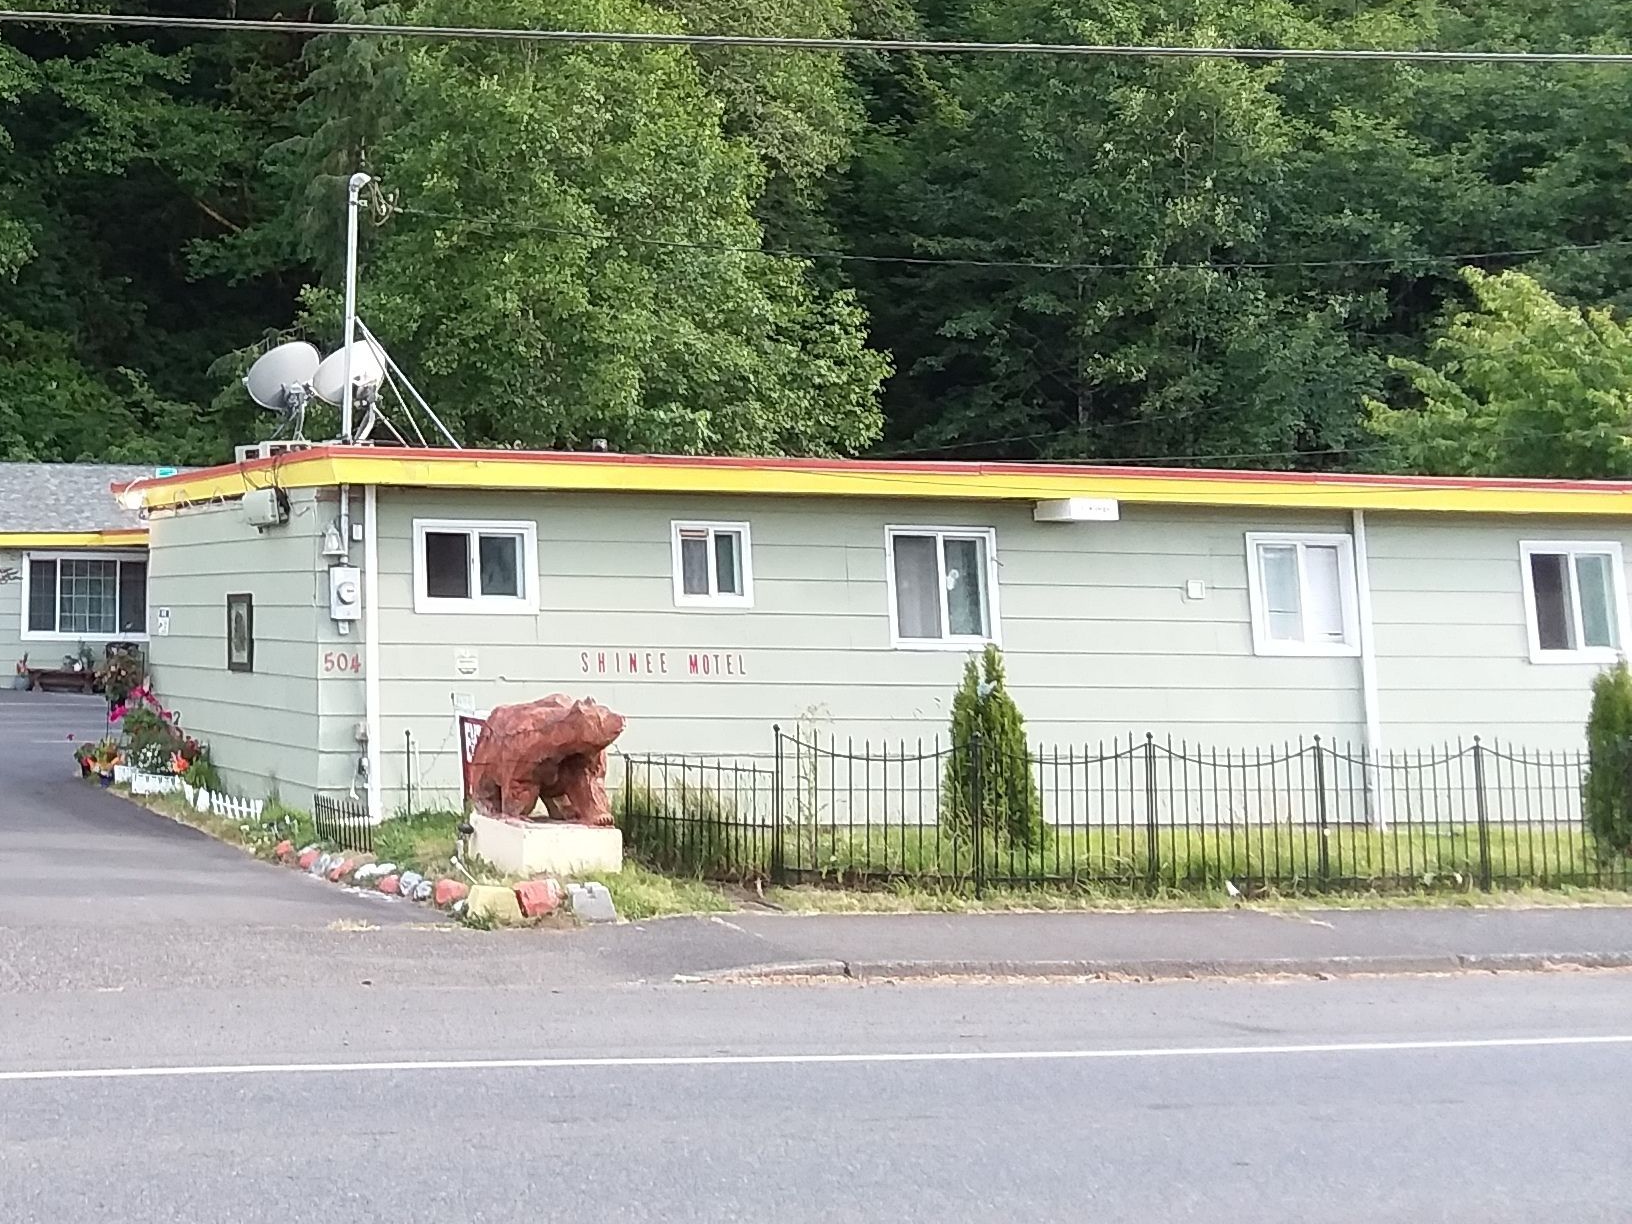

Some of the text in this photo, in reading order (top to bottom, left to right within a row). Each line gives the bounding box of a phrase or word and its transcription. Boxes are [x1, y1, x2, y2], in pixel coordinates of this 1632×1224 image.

[323, 651, 362, 674] 504
[580, 651, 747, 676] SHINEE MOTEL
